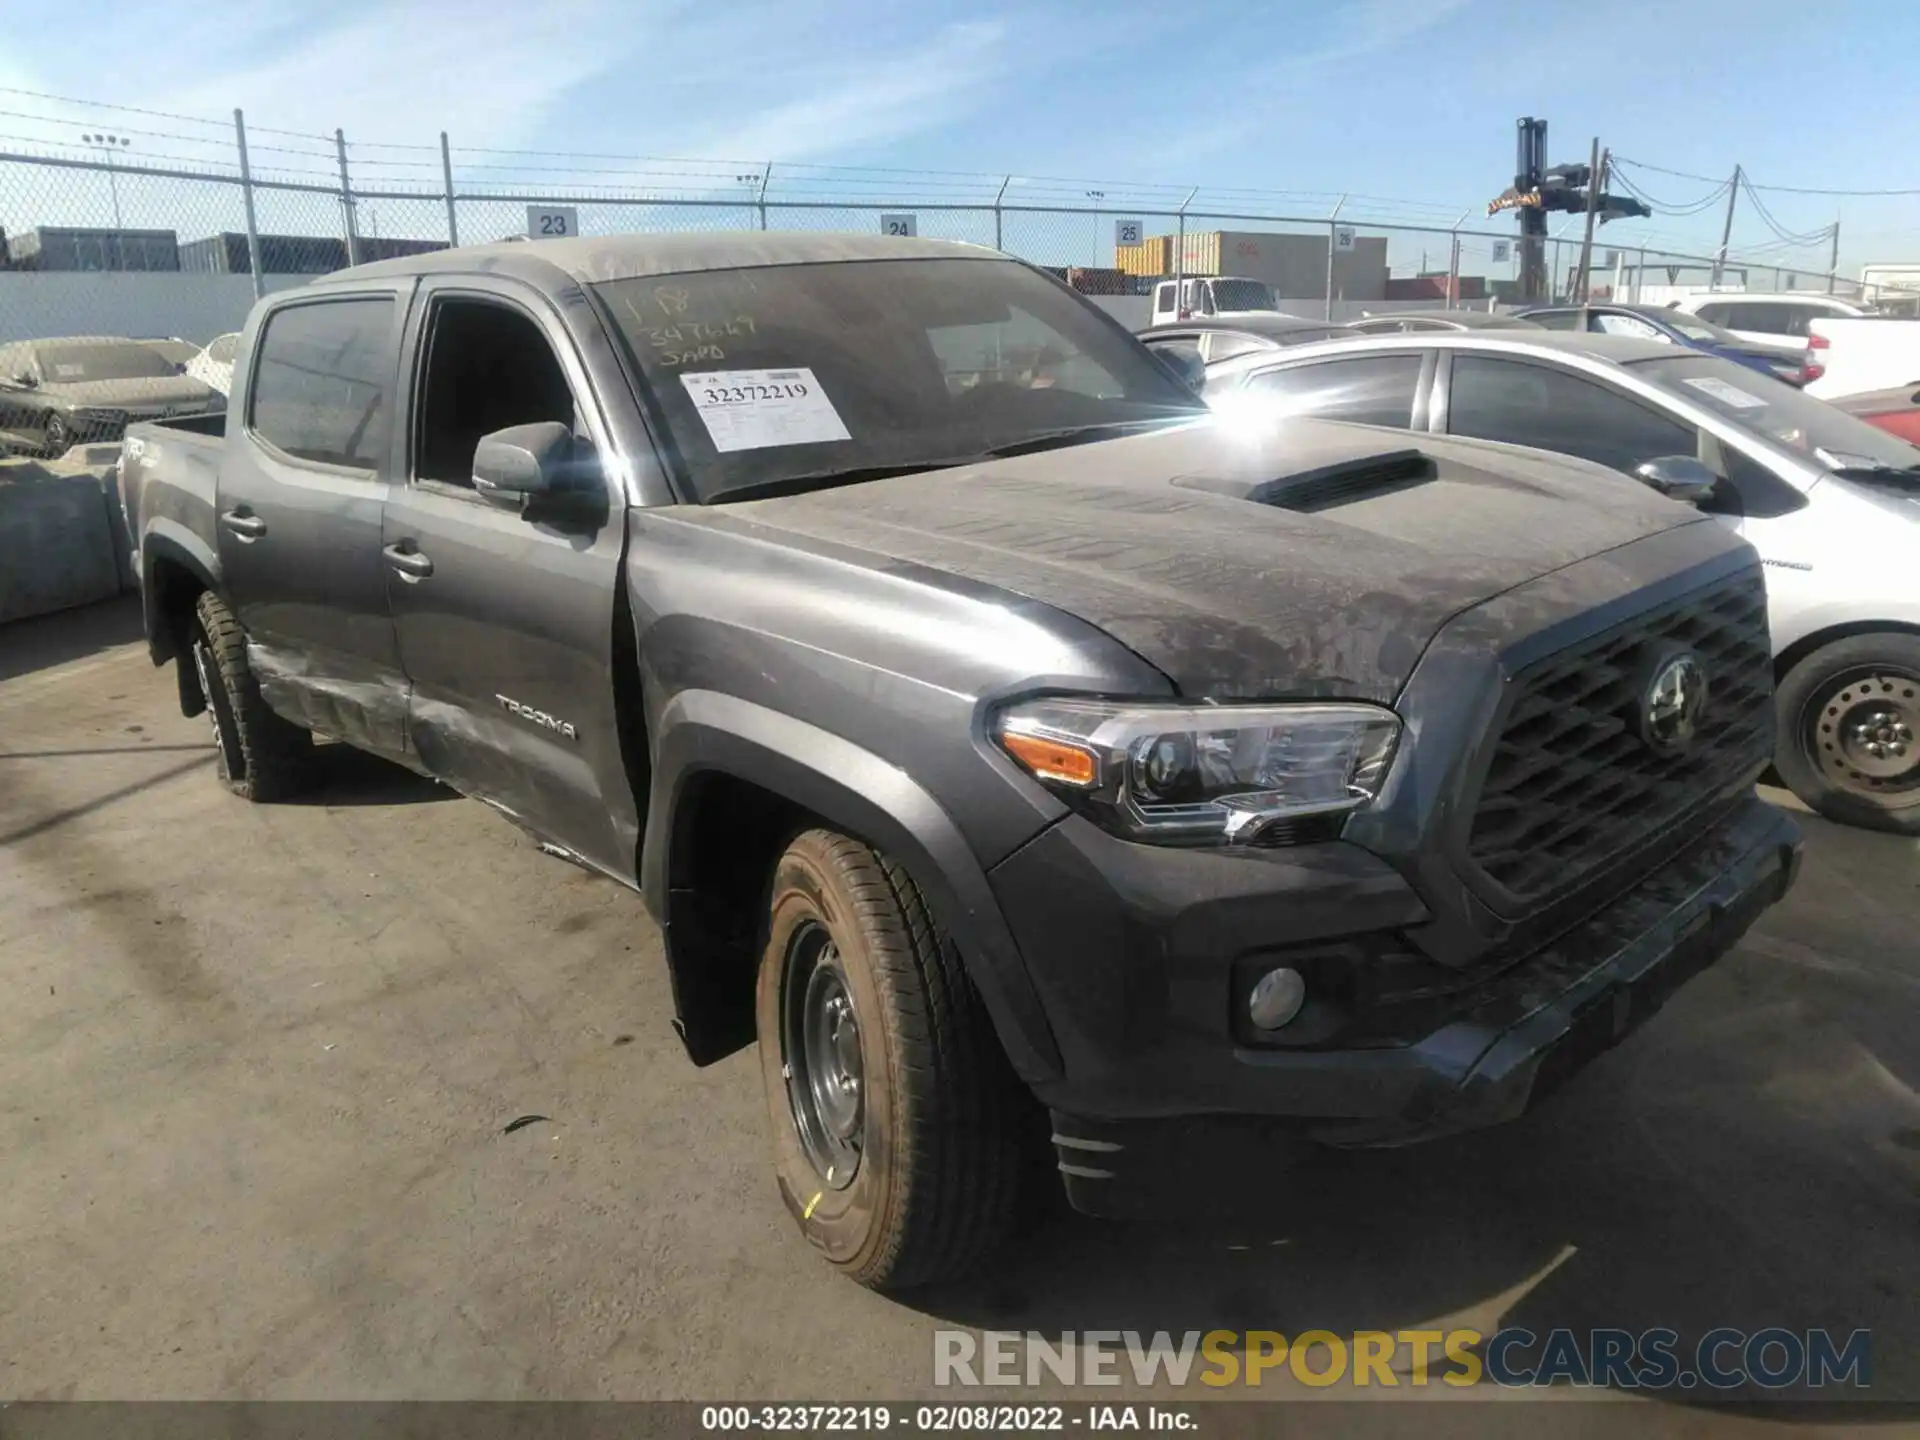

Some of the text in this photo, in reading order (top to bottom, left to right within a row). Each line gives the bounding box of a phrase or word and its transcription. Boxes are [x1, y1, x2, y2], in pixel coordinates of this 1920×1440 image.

[540, 215, 567, 235] 23
[890, 222, 909, 237] 24
[1121, 226, 1138, 241] 25
[703, 383, 809, 404] 32372219
[496, 693, 578, 741] TACOMA
